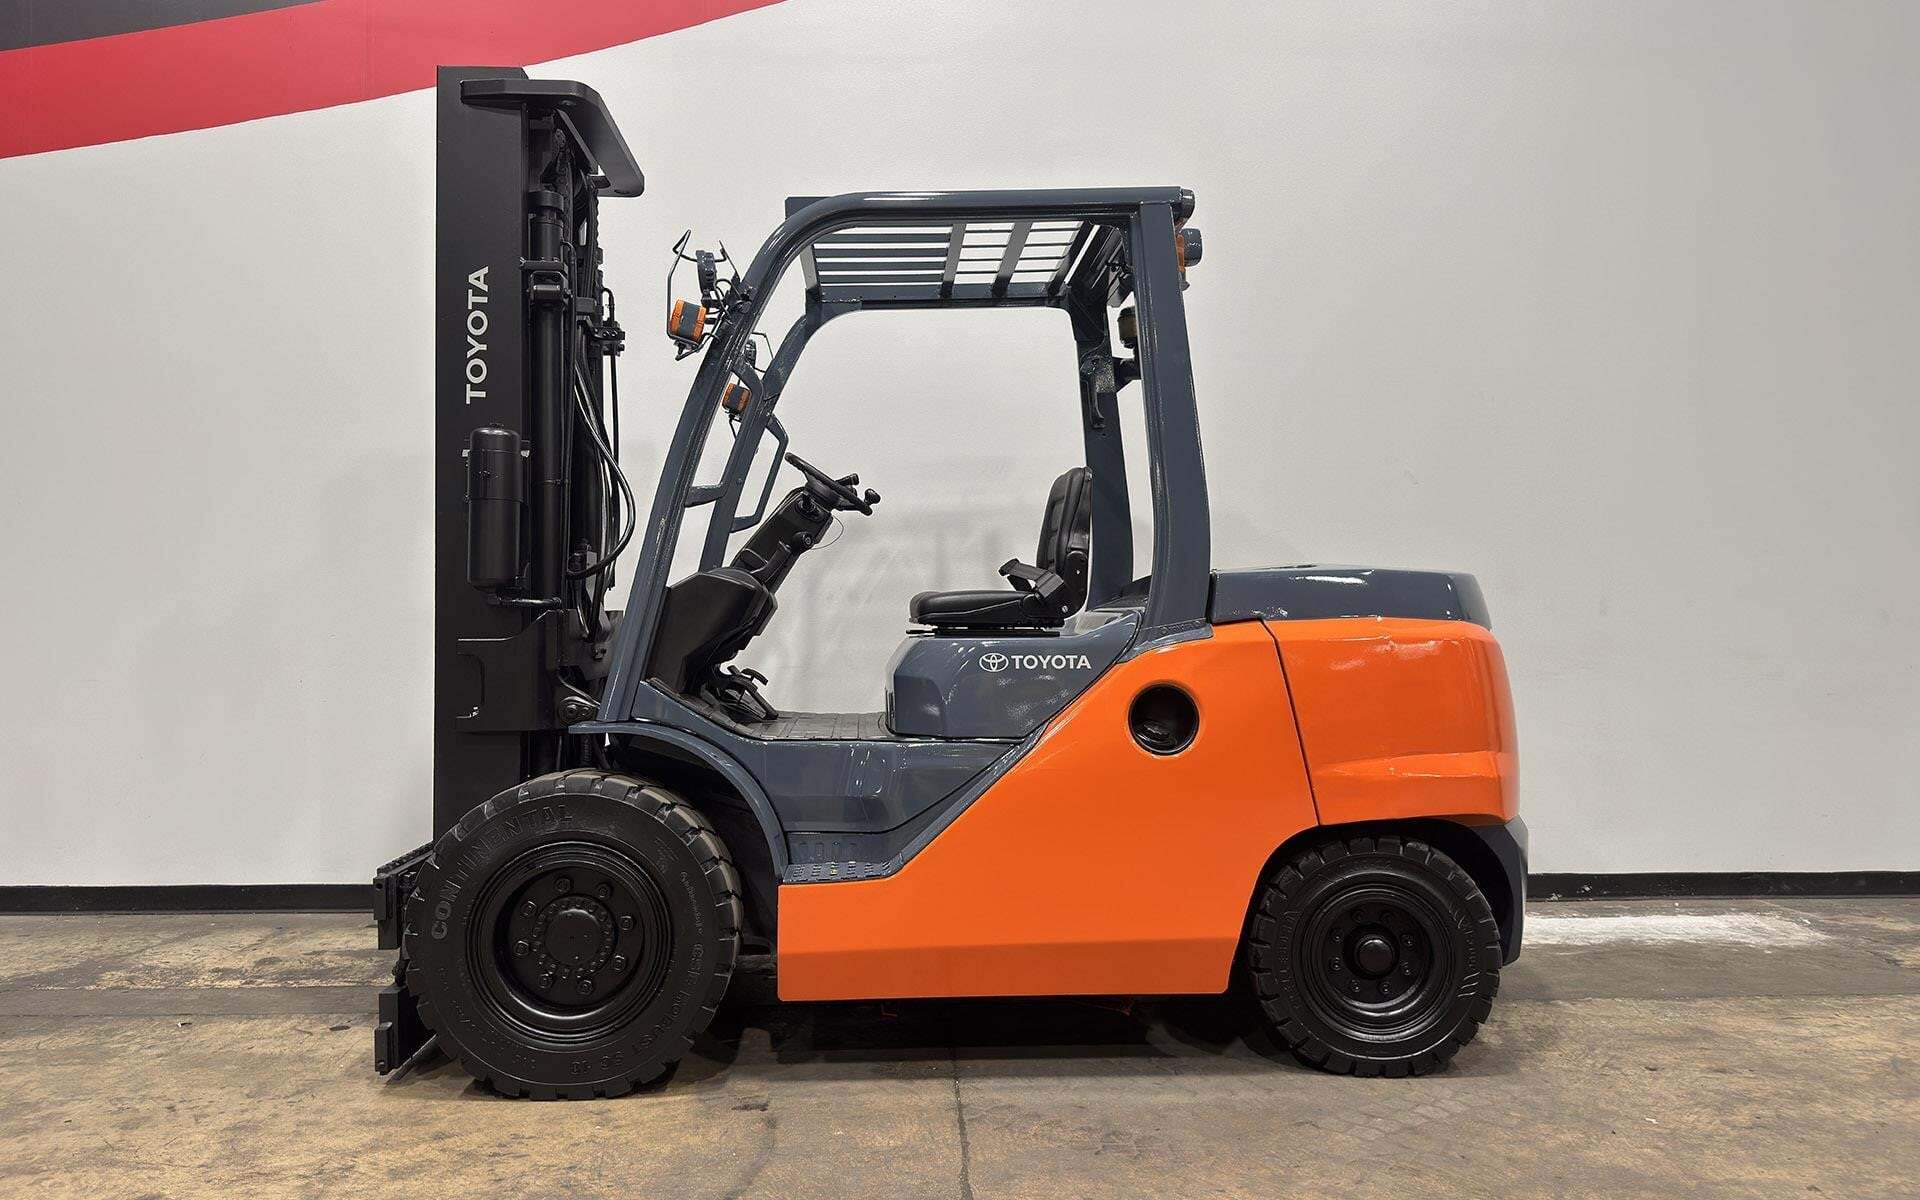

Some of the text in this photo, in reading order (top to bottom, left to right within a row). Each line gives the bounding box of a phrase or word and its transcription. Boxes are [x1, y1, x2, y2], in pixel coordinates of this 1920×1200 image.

[465, 266, 489, 405] TOYOTA
[1010, 654, 1092, 670] TOYOTA
[431, 804, 573, 940] CONTINENTAL
